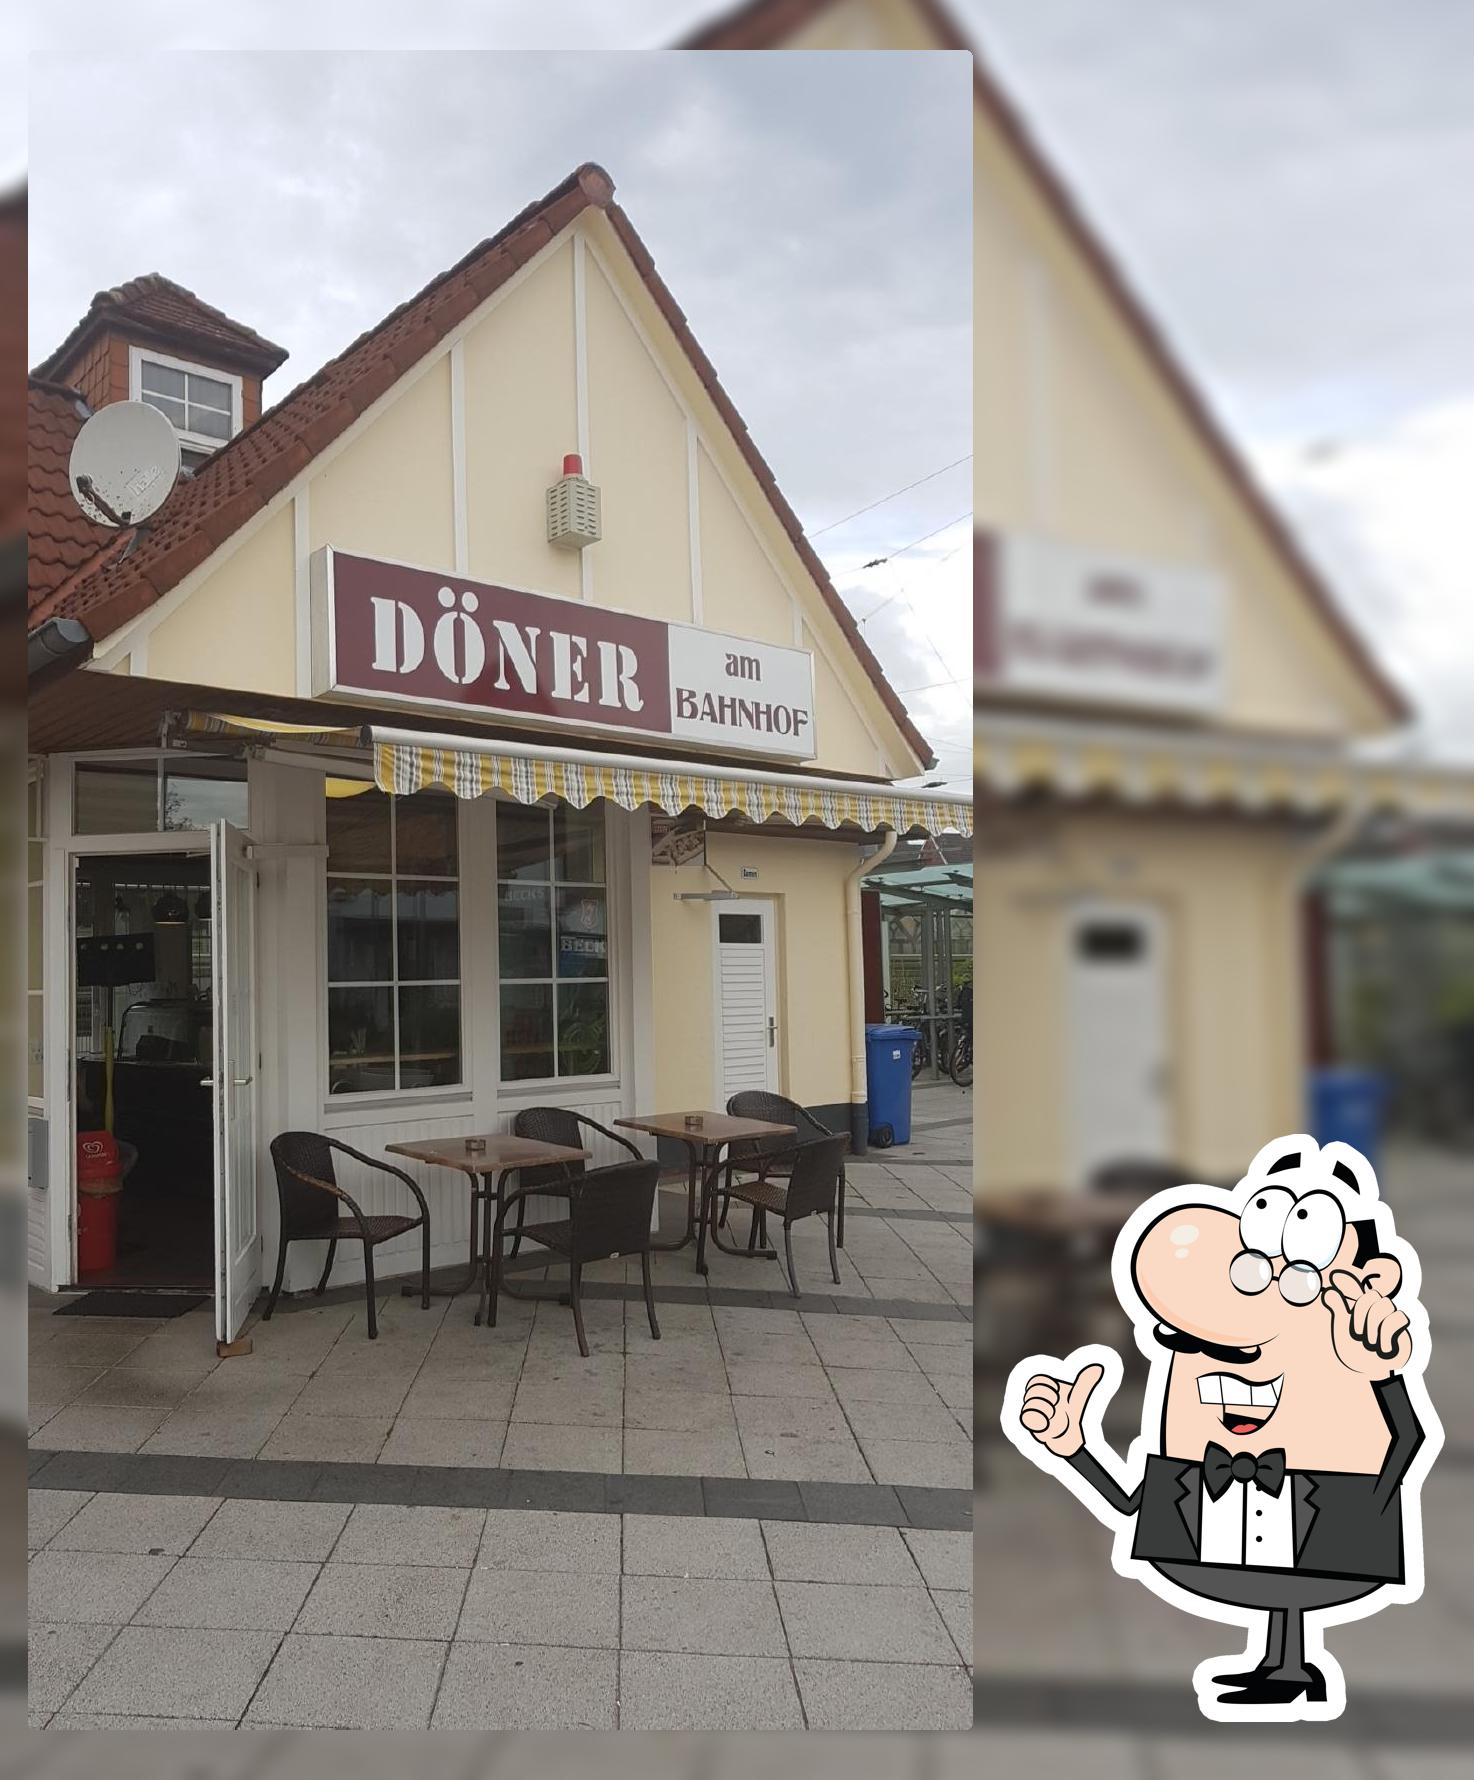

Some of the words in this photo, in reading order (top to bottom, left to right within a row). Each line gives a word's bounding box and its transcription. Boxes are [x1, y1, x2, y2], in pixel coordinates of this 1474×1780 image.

[370, 586, 645, 712] DÖNER
[724, 651, 762, 682] am
[675, 686, 809, 738] BAHNHOF
